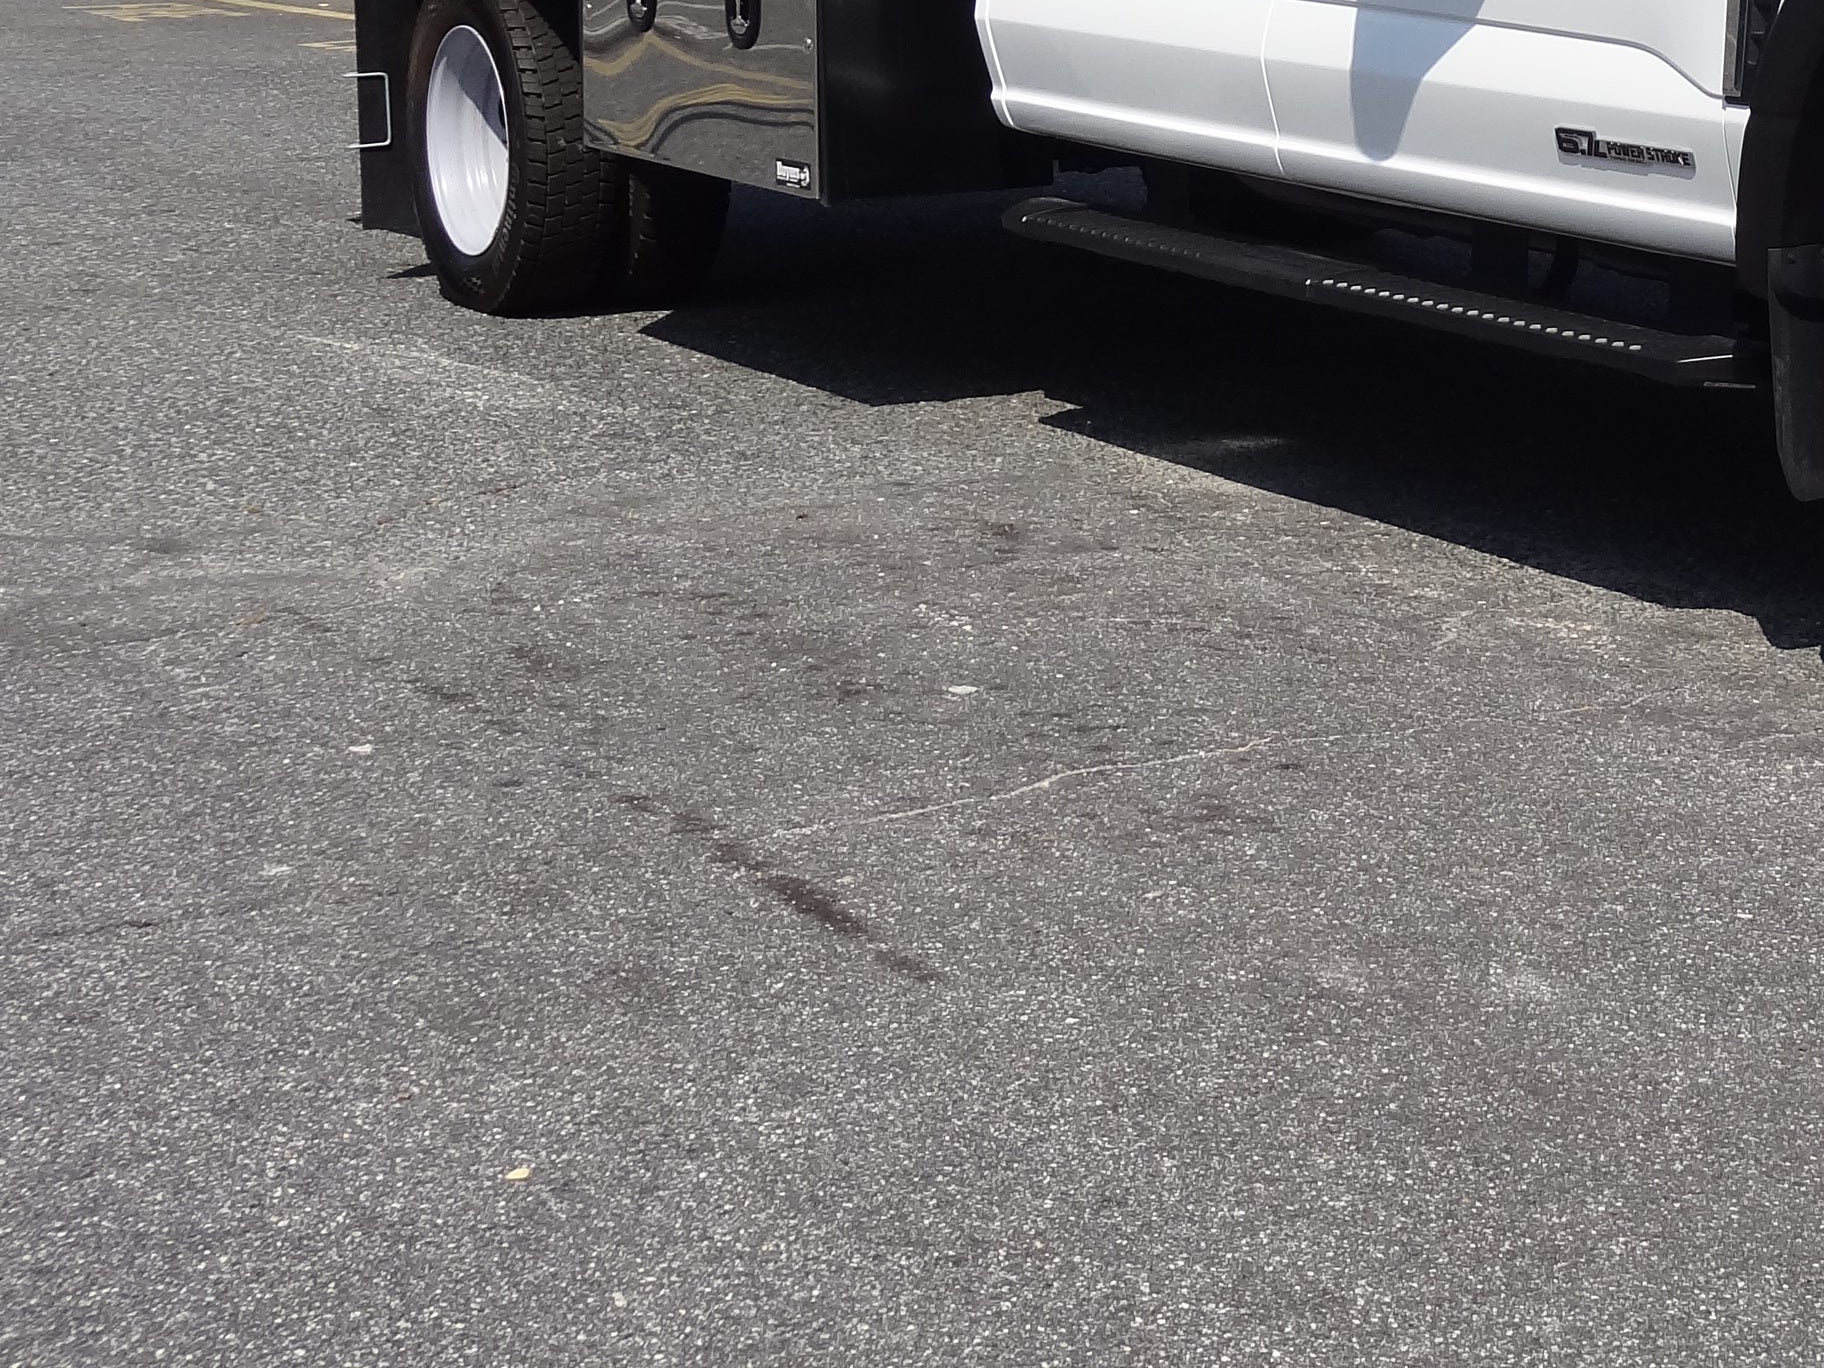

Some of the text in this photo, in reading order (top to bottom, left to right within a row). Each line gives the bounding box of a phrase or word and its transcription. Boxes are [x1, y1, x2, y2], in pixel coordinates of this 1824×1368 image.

[1554, 126, 1608, 158] 6.7L
[1607, 141, 1645, 158] POWER
[1645, 145, 1691, 166] STROKE
